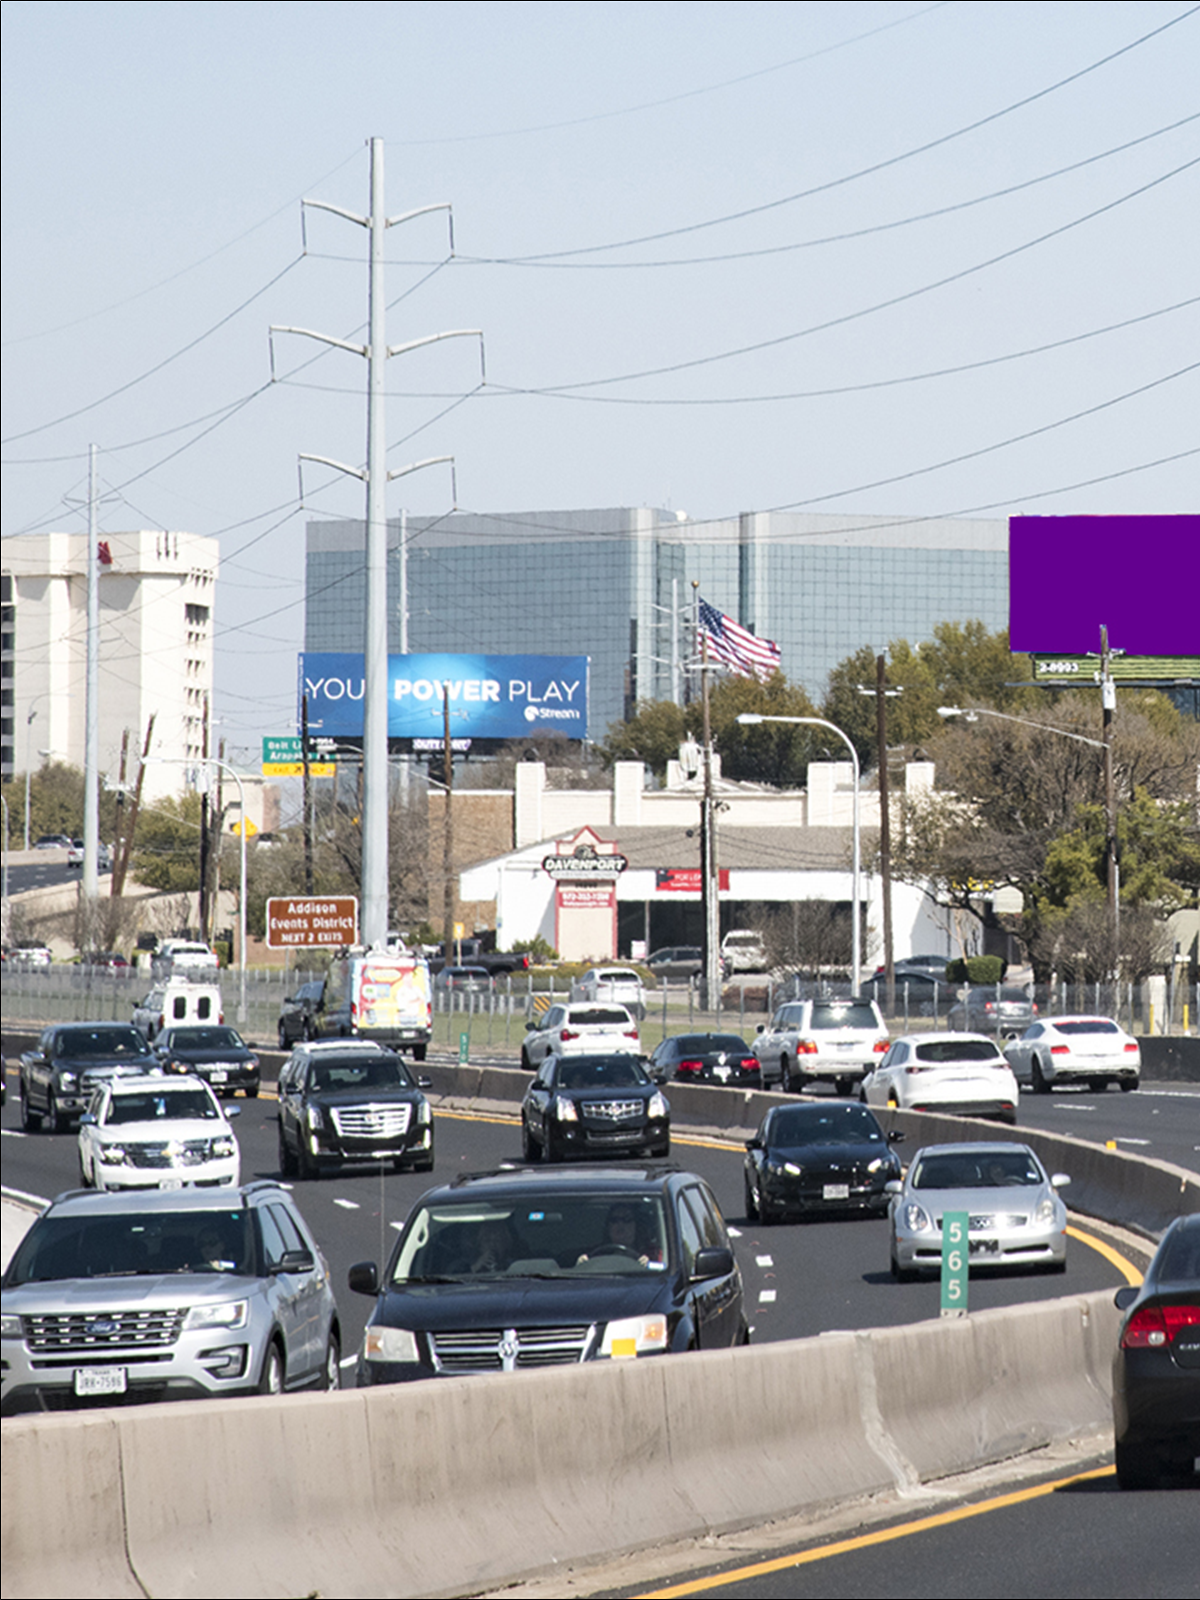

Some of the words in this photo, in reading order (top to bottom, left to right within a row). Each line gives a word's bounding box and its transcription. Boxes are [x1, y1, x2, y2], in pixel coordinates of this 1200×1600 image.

[304, 677, 366, 701] YOU
[394, 679, 500, 702] POWER
[508, 680, 580, 703] PLAY
[268, 741, 289, 750] Belt
[545, 859, 626, 871] DAVENPORT
[287, 902, 337, 914] Addison
[270, 917, 308, 930] Events
[312, 916, 353, 929] District
[281, 932, 305, 943] NEXT
[308, 932, 315, 943] 2
[317, 932, 343, 943] EXITS
[948, 1222, 962, 1300] 565
